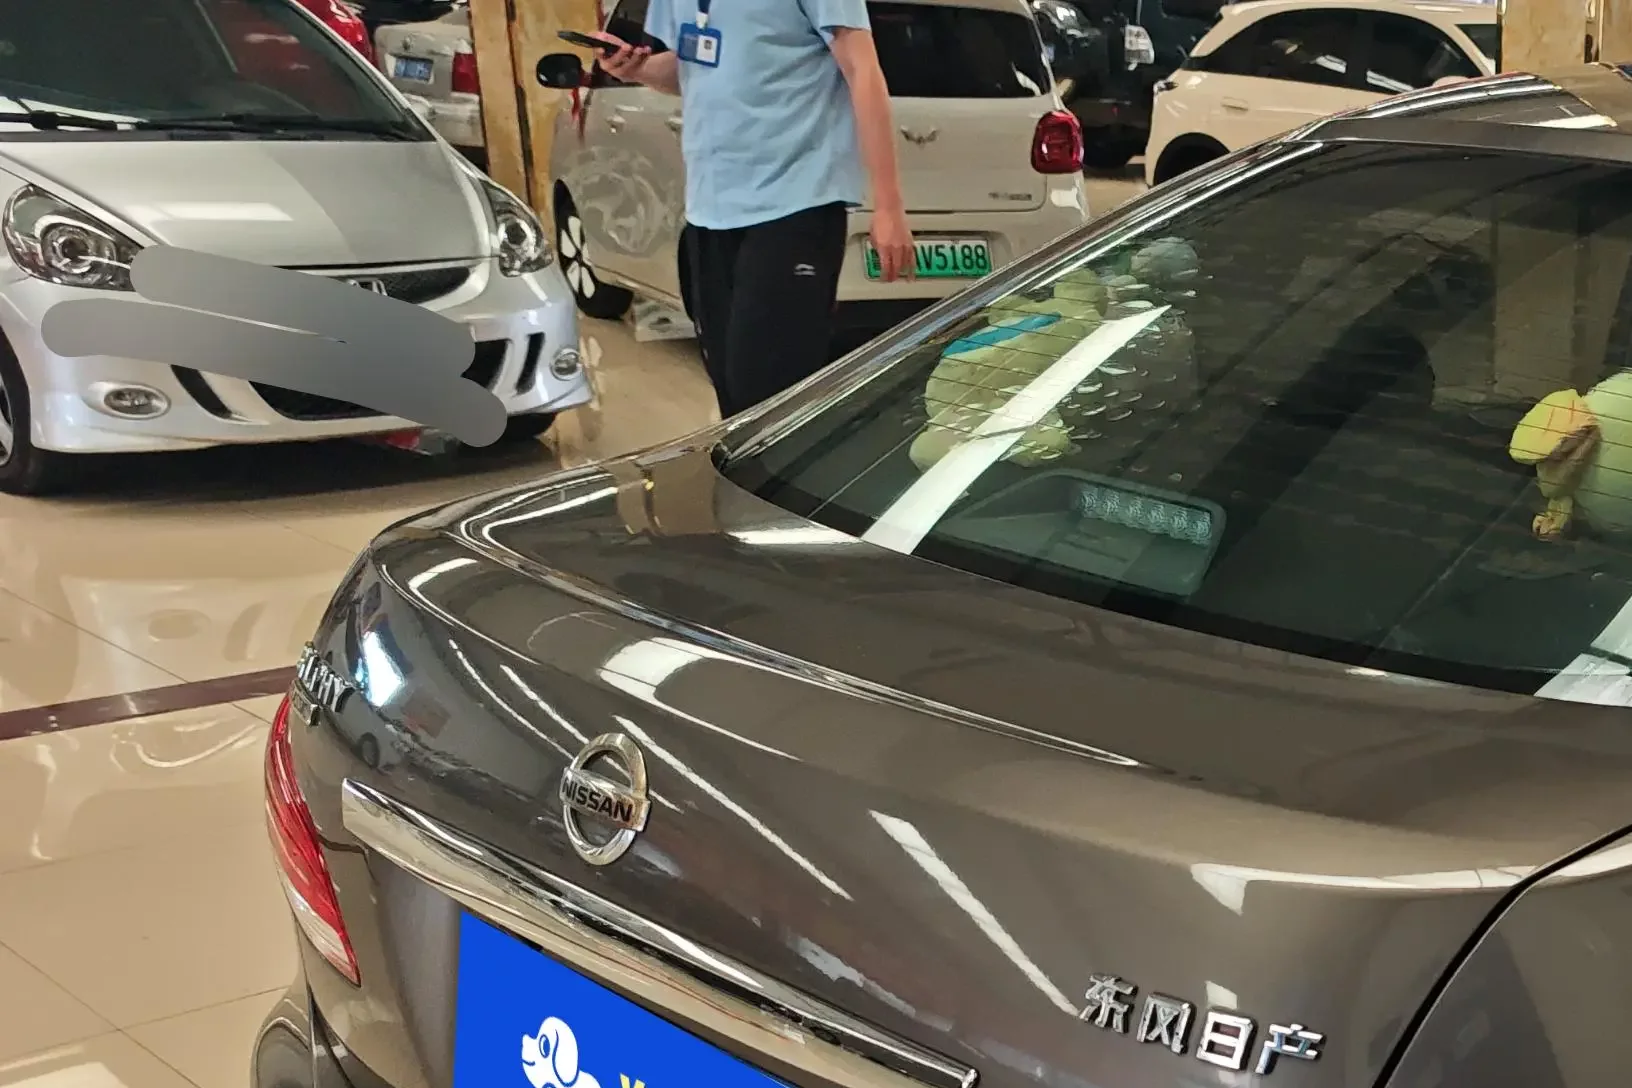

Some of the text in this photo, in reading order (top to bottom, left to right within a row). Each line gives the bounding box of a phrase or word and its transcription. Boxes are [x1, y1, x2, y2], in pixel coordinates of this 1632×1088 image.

[562, 777, 633, 822] NISSAN
[1079, 974, 1324, 1074] 东风日产
